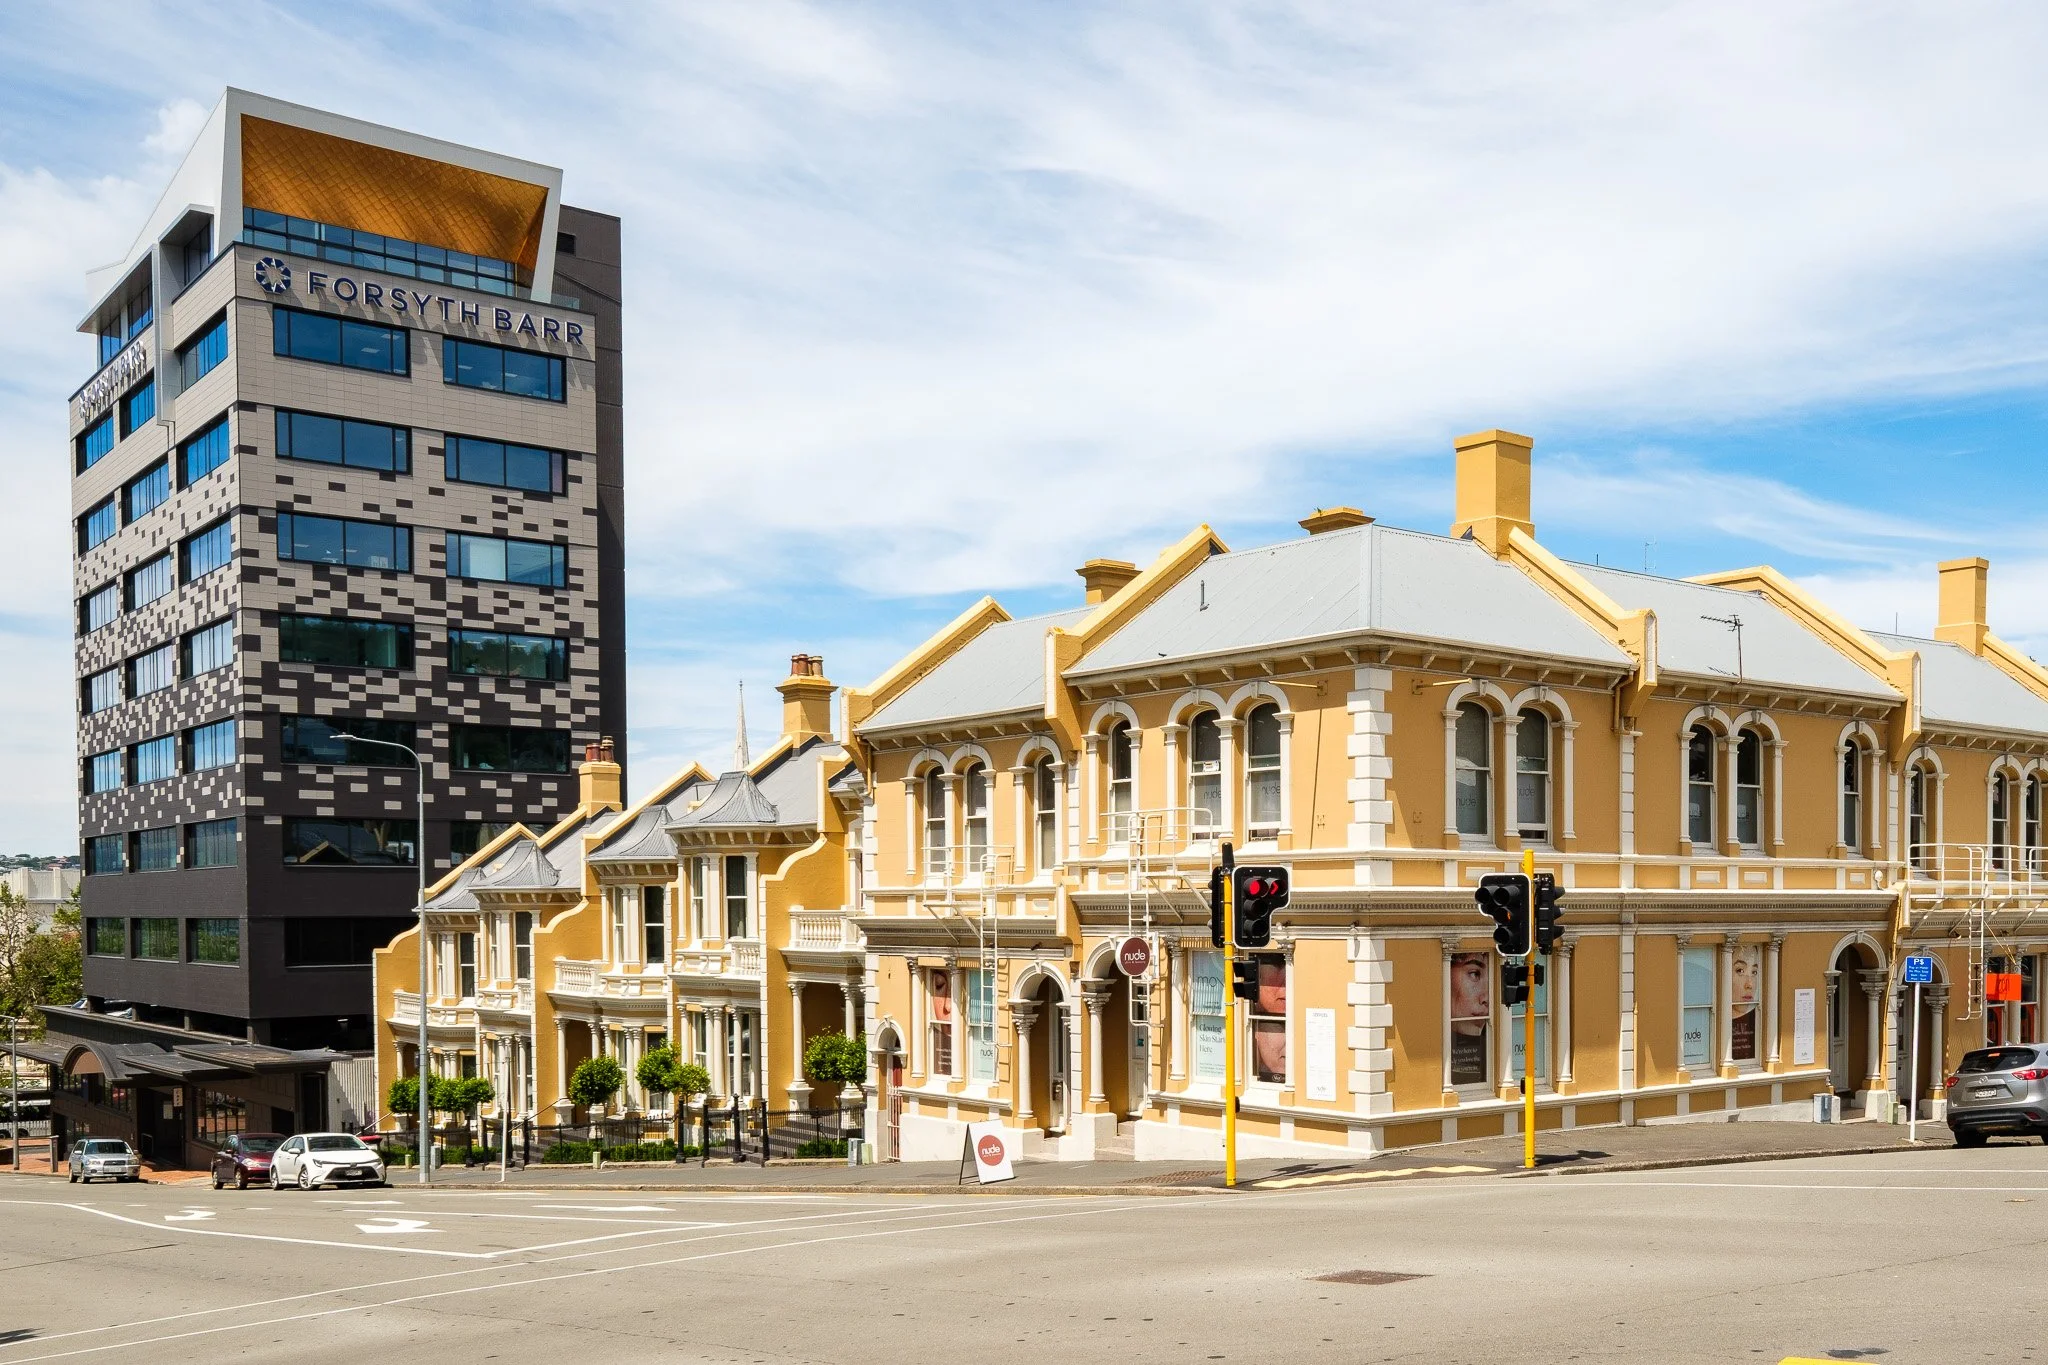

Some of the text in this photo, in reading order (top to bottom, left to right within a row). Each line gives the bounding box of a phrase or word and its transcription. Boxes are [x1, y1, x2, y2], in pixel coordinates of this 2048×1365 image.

[307, 270, 584, 345] FORSYTH BARR
[1124, 949, 1146, 961] nude
[1684, 1028, 1702, 1040] nude
[981, 1144, 1001, 1155] nude
